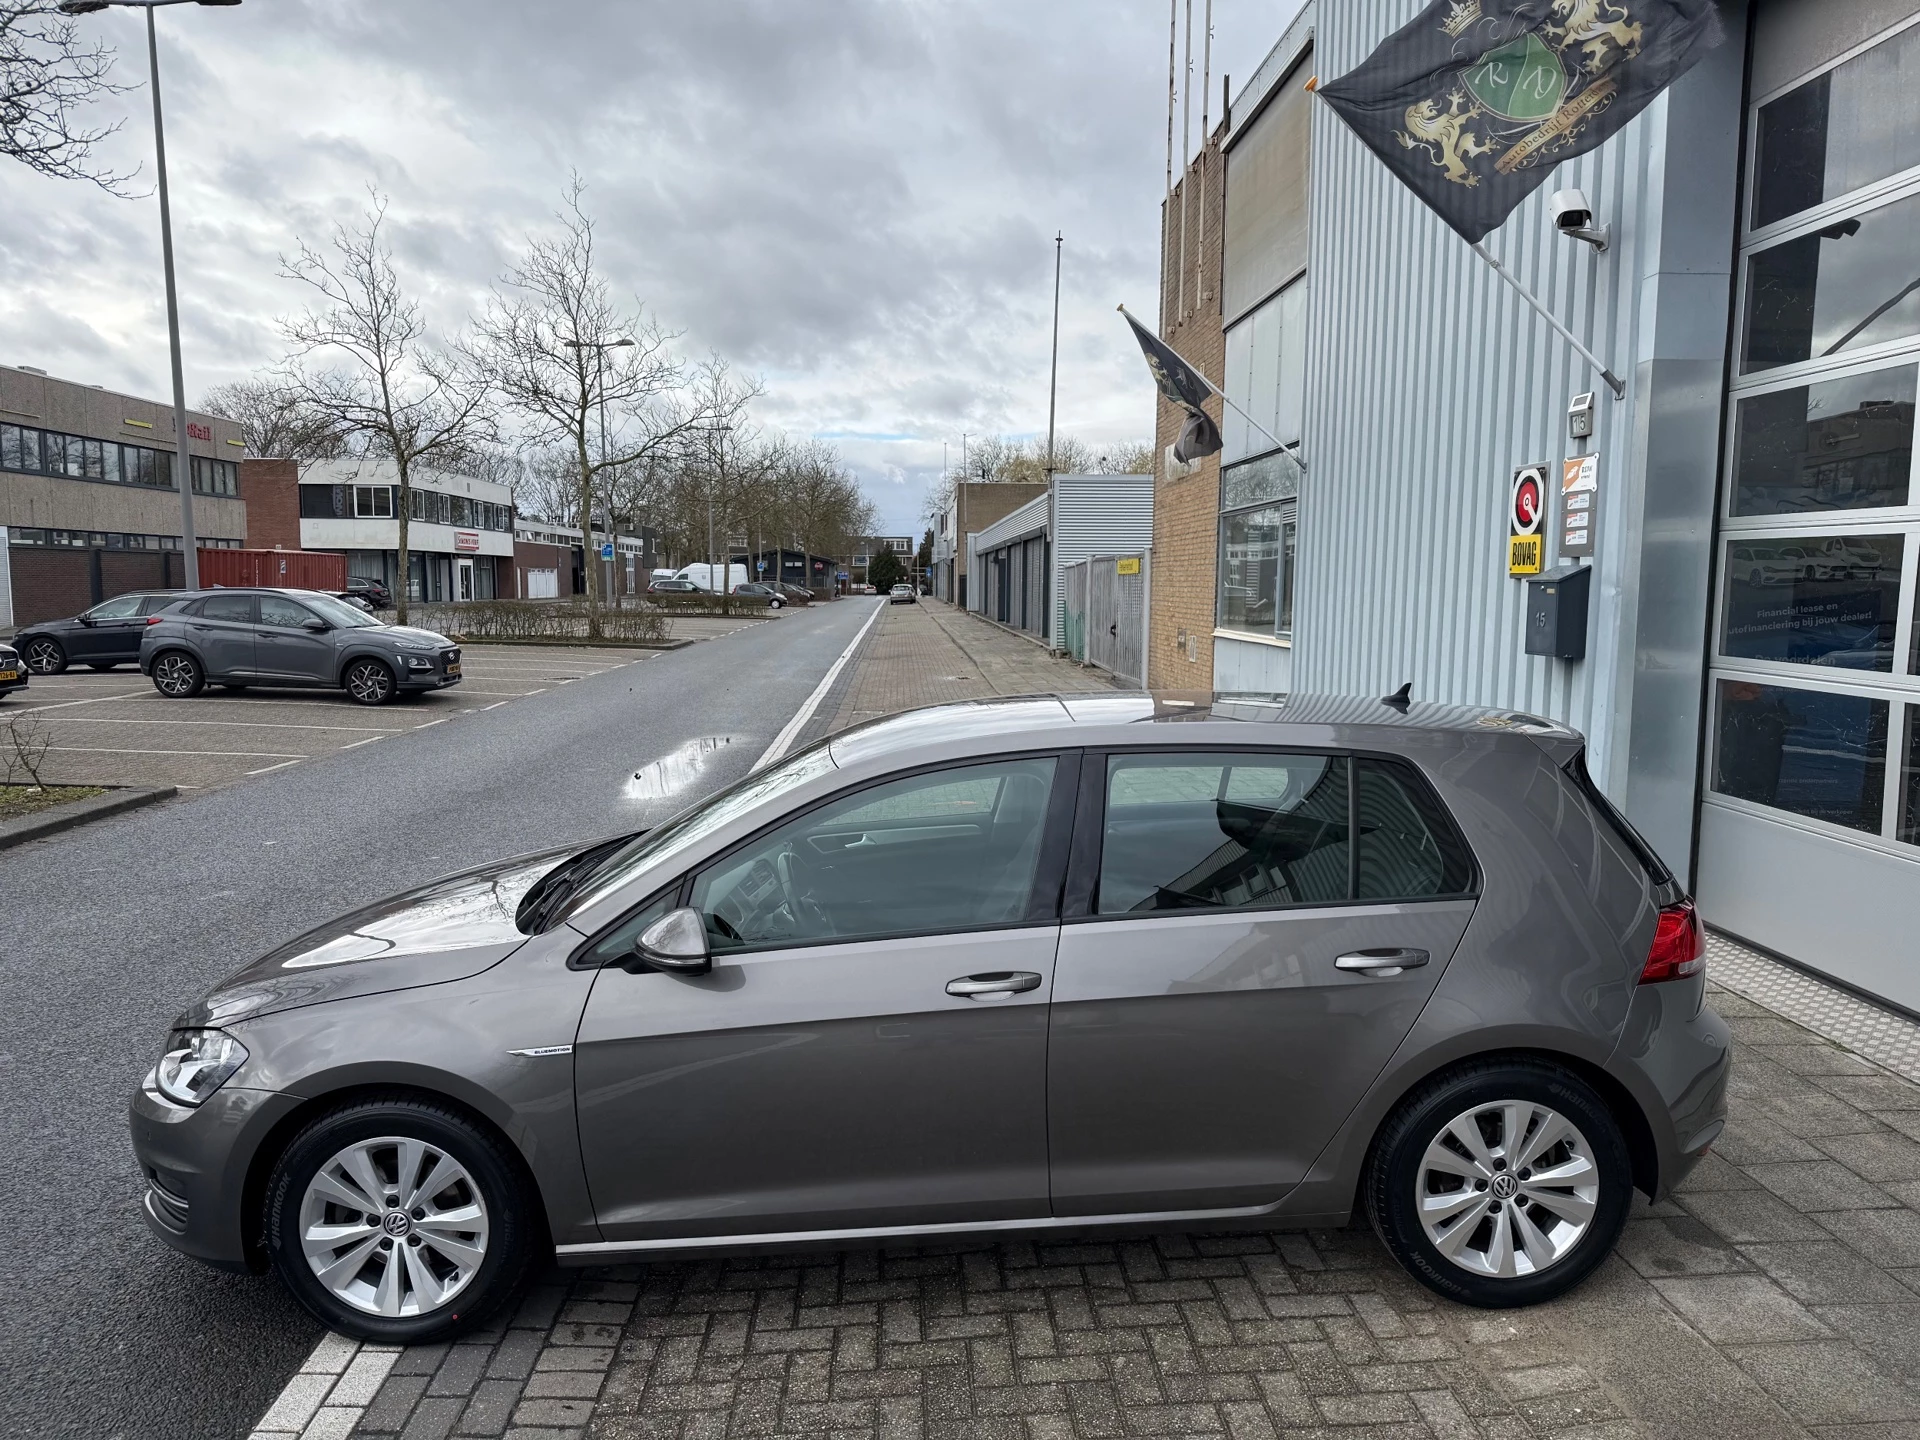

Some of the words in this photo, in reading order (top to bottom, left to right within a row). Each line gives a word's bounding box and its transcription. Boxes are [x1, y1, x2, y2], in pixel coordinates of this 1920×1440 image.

[1501, 114, 1564, 171] Autobedrijf
[1572, 414, 1586, 433] 15
[1512, 541, 1537, 567] BOVAG
[1535, 612, 1546, 628] 15
[1756, 606, 1799, 619] Financial
[1800, 604, 1824, 613] lease
[1826, 603, 1839, 611] en
[1728, 619, 1800, 635] utofinanciering
[1802, 617, 1814, 628] bij
[1814, 615, 1839, 627] jouw
[1840, 611, 1872, 622] dealer!
